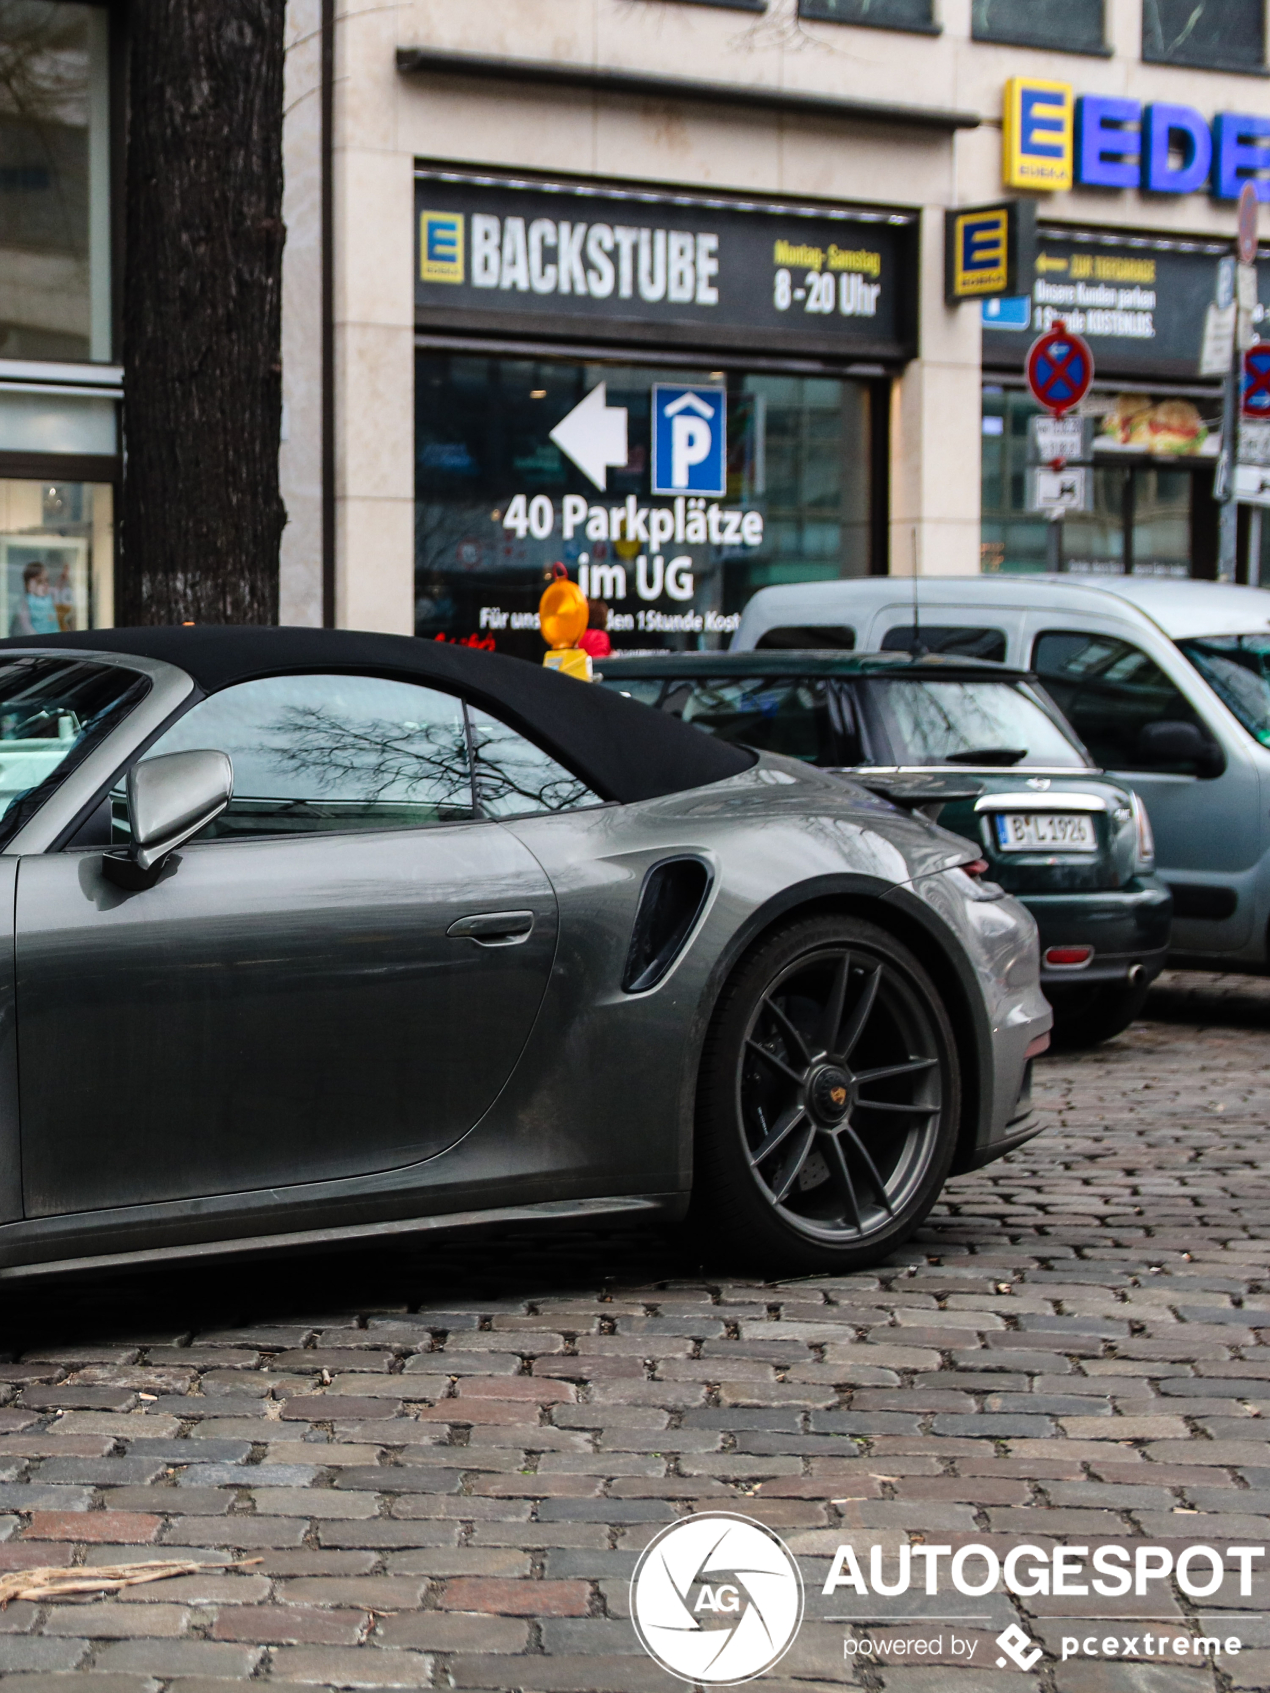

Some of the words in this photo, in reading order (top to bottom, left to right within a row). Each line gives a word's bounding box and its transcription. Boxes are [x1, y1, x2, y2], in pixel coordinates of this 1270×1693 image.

[470, 212, 719, 306] BACKSTUBE
[827, 244, 881, 278] Samstag
[839, 272, 881, 317] Uhr
[1034, 278, 1076, 305] Unsere
[1076, 281, 1117, 308] Kunden
[1117, 285, 1156, 310] parken
[671, 414, 712, 489] P
[503, 494, 554, 539] 40
[562, 494, 764, 554] Parkplätze
[578, 552, 626, 600] im
[635, 555, 695, 601] UG
[480, 607, 509, 629] Für
[1013, 816, 1025, 841] B
